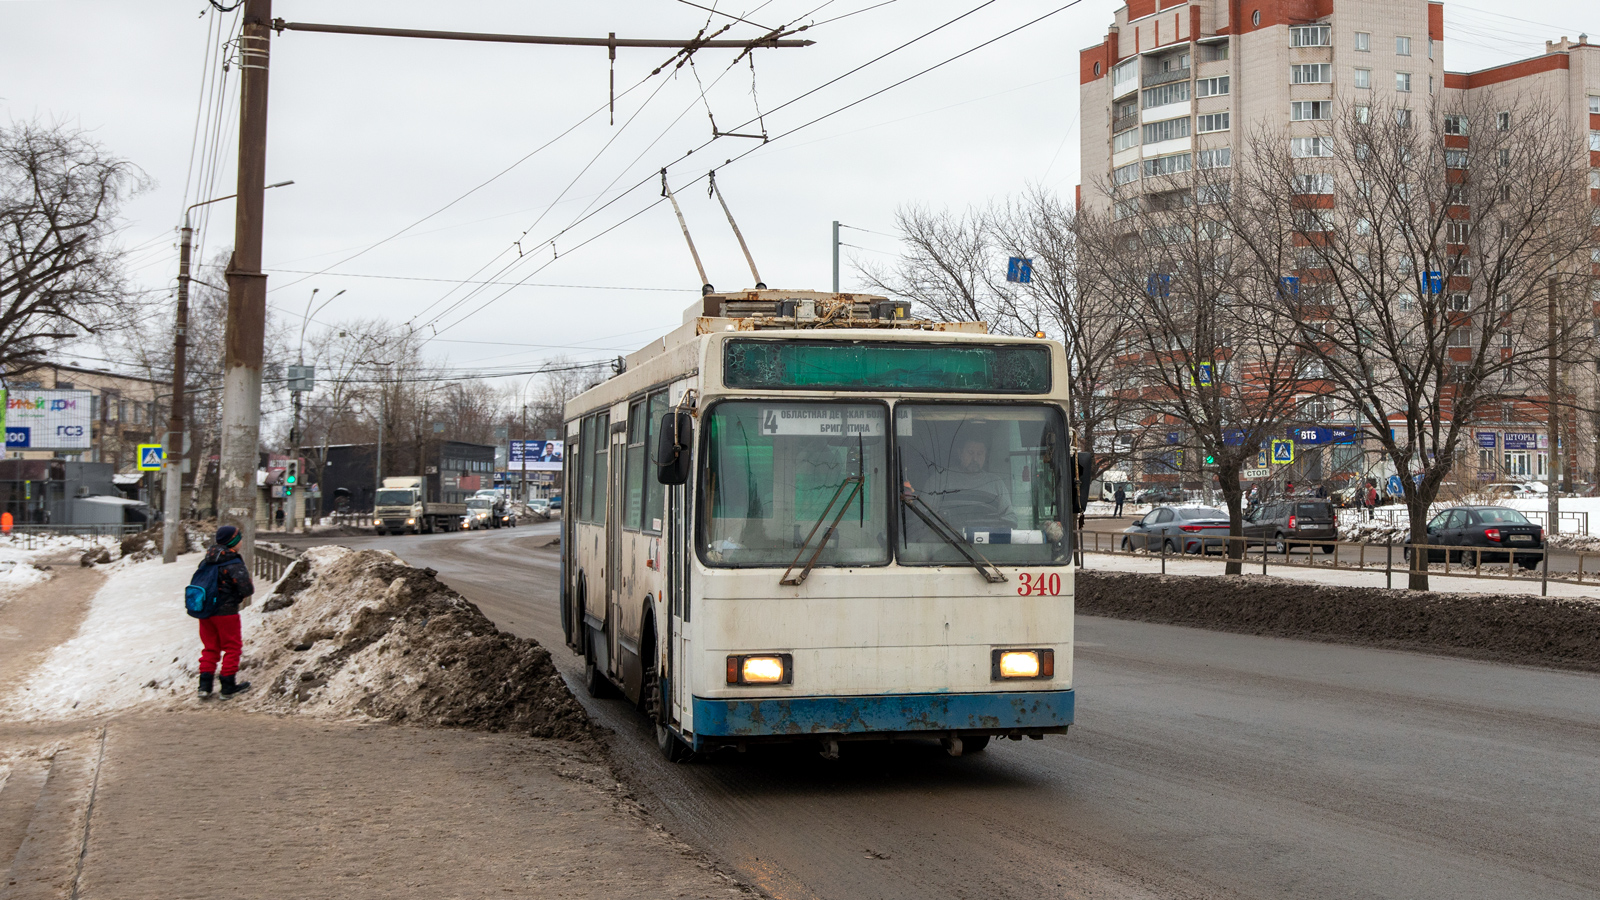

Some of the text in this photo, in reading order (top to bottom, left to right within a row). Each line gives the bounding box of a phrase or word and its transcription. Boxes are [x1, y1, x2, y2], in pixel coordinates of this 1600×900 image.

[51, 399, 76, 411] ДОМ
[781, 410, 827, 419] ОБЛАСТНАЯ
[764, 410, 778, 434] 4
[1301, 431, 1317, 440] ВТБ
[1505, 433, 1535, 441] ШТОРЫ
[1246, 469, 1267, 478] СТОП
[1017, 572, 1061, 597] 340
